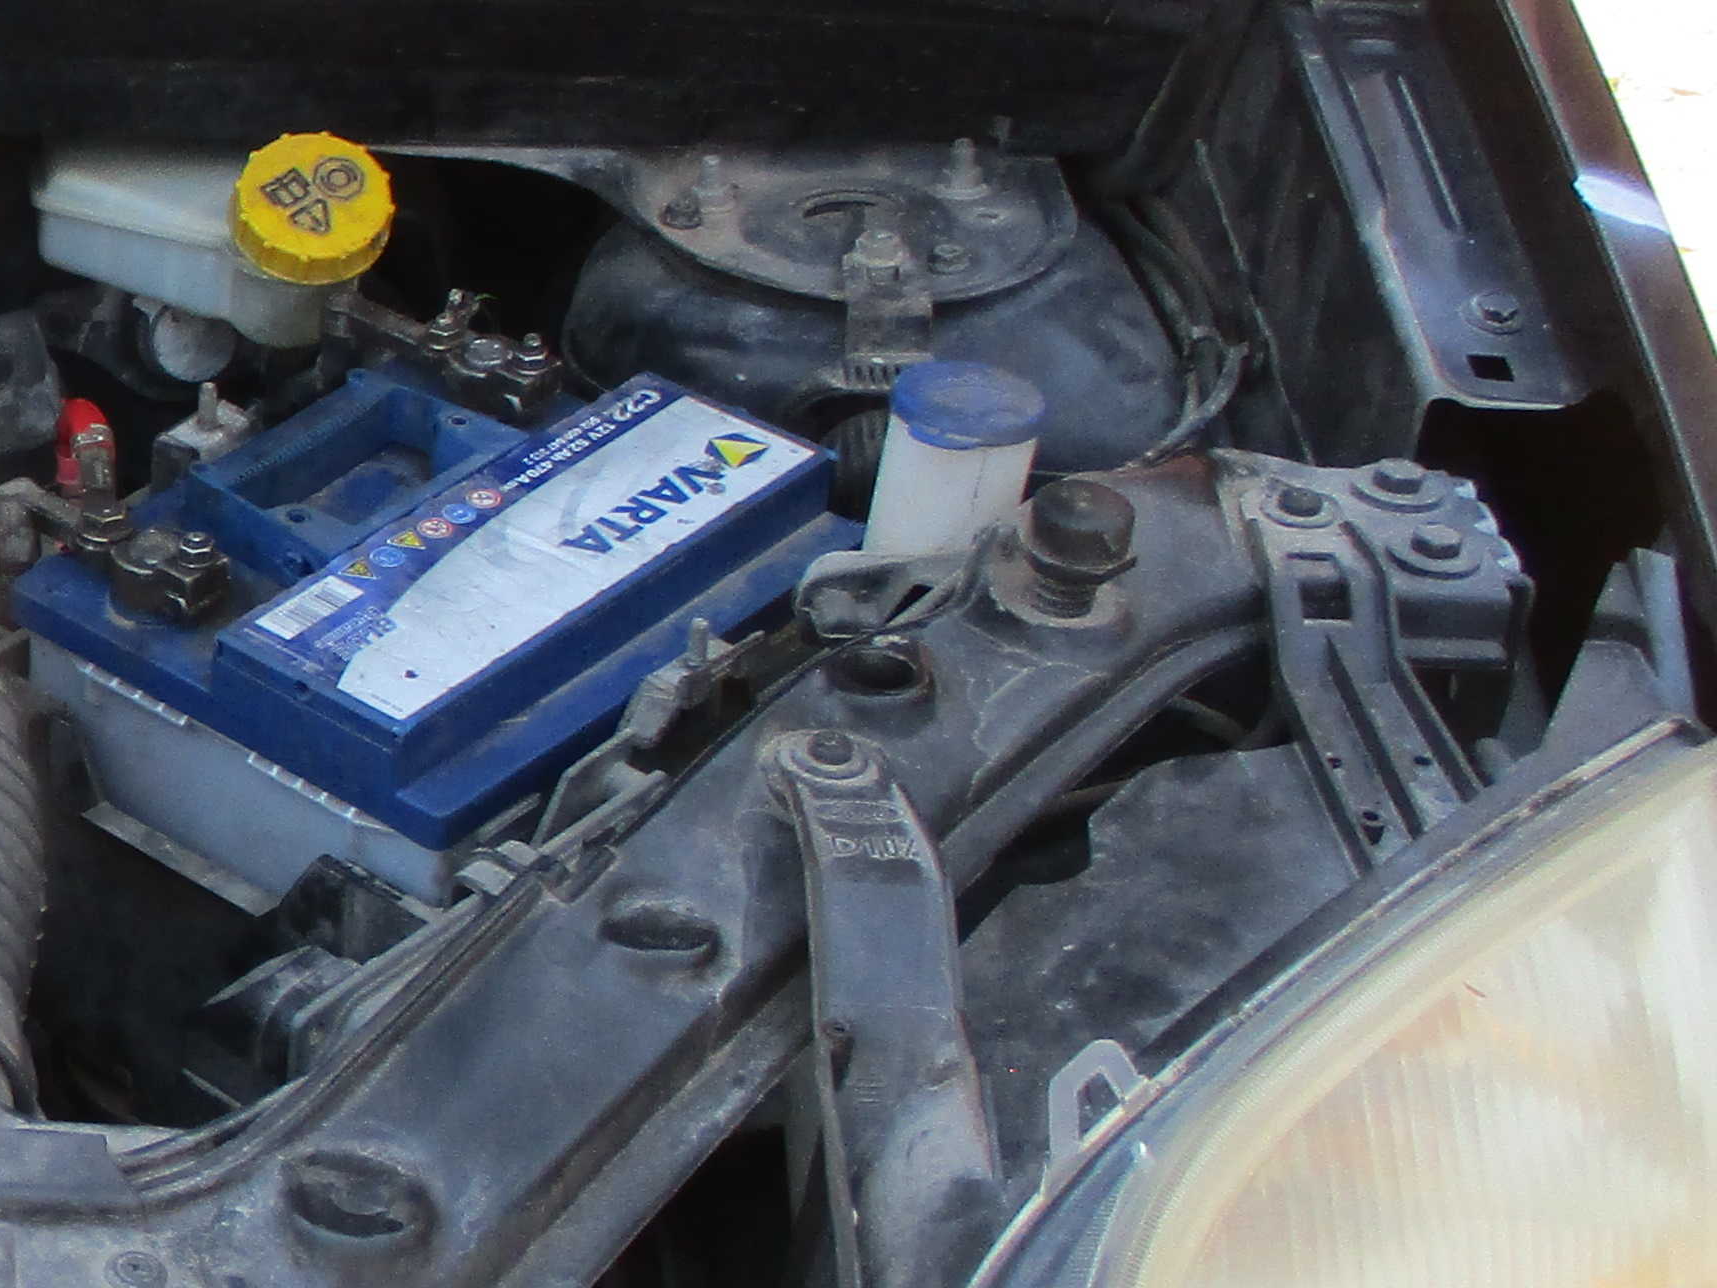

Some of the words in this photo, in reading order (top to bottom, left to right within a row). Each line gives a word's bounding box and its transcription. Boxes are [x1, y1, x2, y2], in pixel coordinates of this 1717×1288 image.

[603, 389, 661, 422] C22
[588, 423, 616, 441] 12V
[558, 465, 726, 554] VARTA
